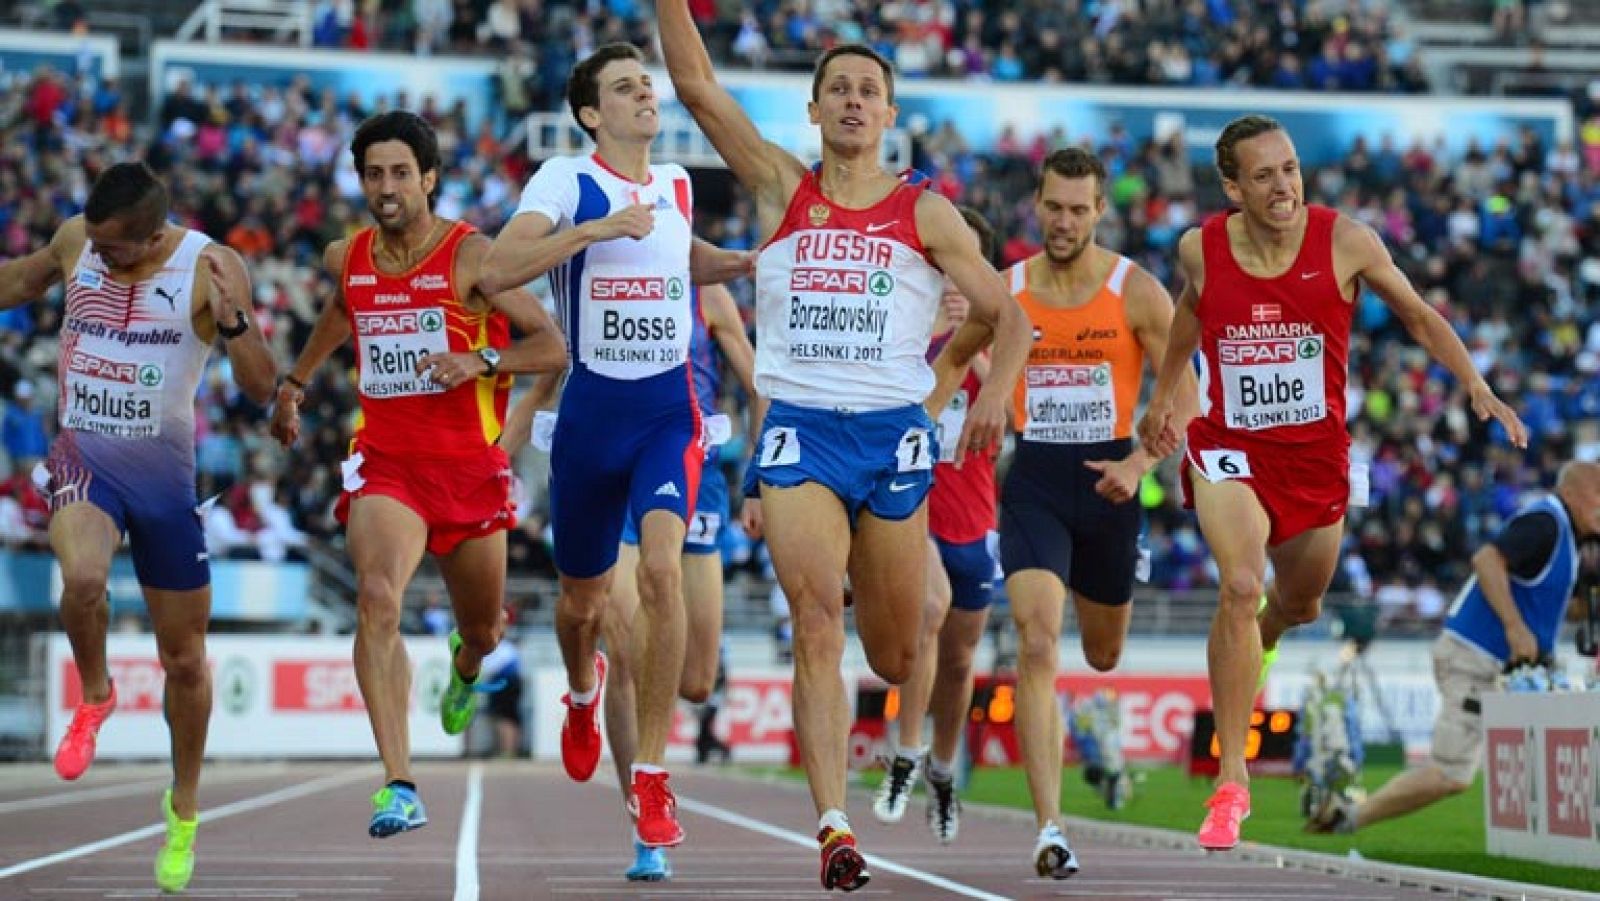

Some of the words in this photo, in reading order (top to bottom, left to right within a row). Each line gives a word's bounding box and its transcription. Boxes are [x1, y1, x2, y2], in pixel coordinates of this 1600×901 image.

[795, 233, 893, 267] RUSSIA
[592, 279, 663, 299] SPAR
[791, 271, 865, 292] SPAR
[357, 315, 417, 335] SPAR
[603, 310, 676, 341] Bosse
[789, 296, 889, 343] Borzakovskiy
[66, 317, 105, 338] czech
[107, 328, 183, 347] republic
[1225, 323, 1313, 340] DANMARK
[594, 347, 655, 362] HELSINKI
[790, 344, 849, 360] HELSINKI
[854, 346, 883, 361] 2012
[1220, 344, 1294, 363] SPAR
[70, 354, 135, 381] SPAR
[1028, 368, 1090, 387] SPAR
[365, 379, 416, 396] HELSINKI
[1239, 374, 1305, 407] Bube
[72, 382, 151, 420] Holuša
[1294, 404, 1320, 421] 2012
[1217, 455, 1240, 475] 6
